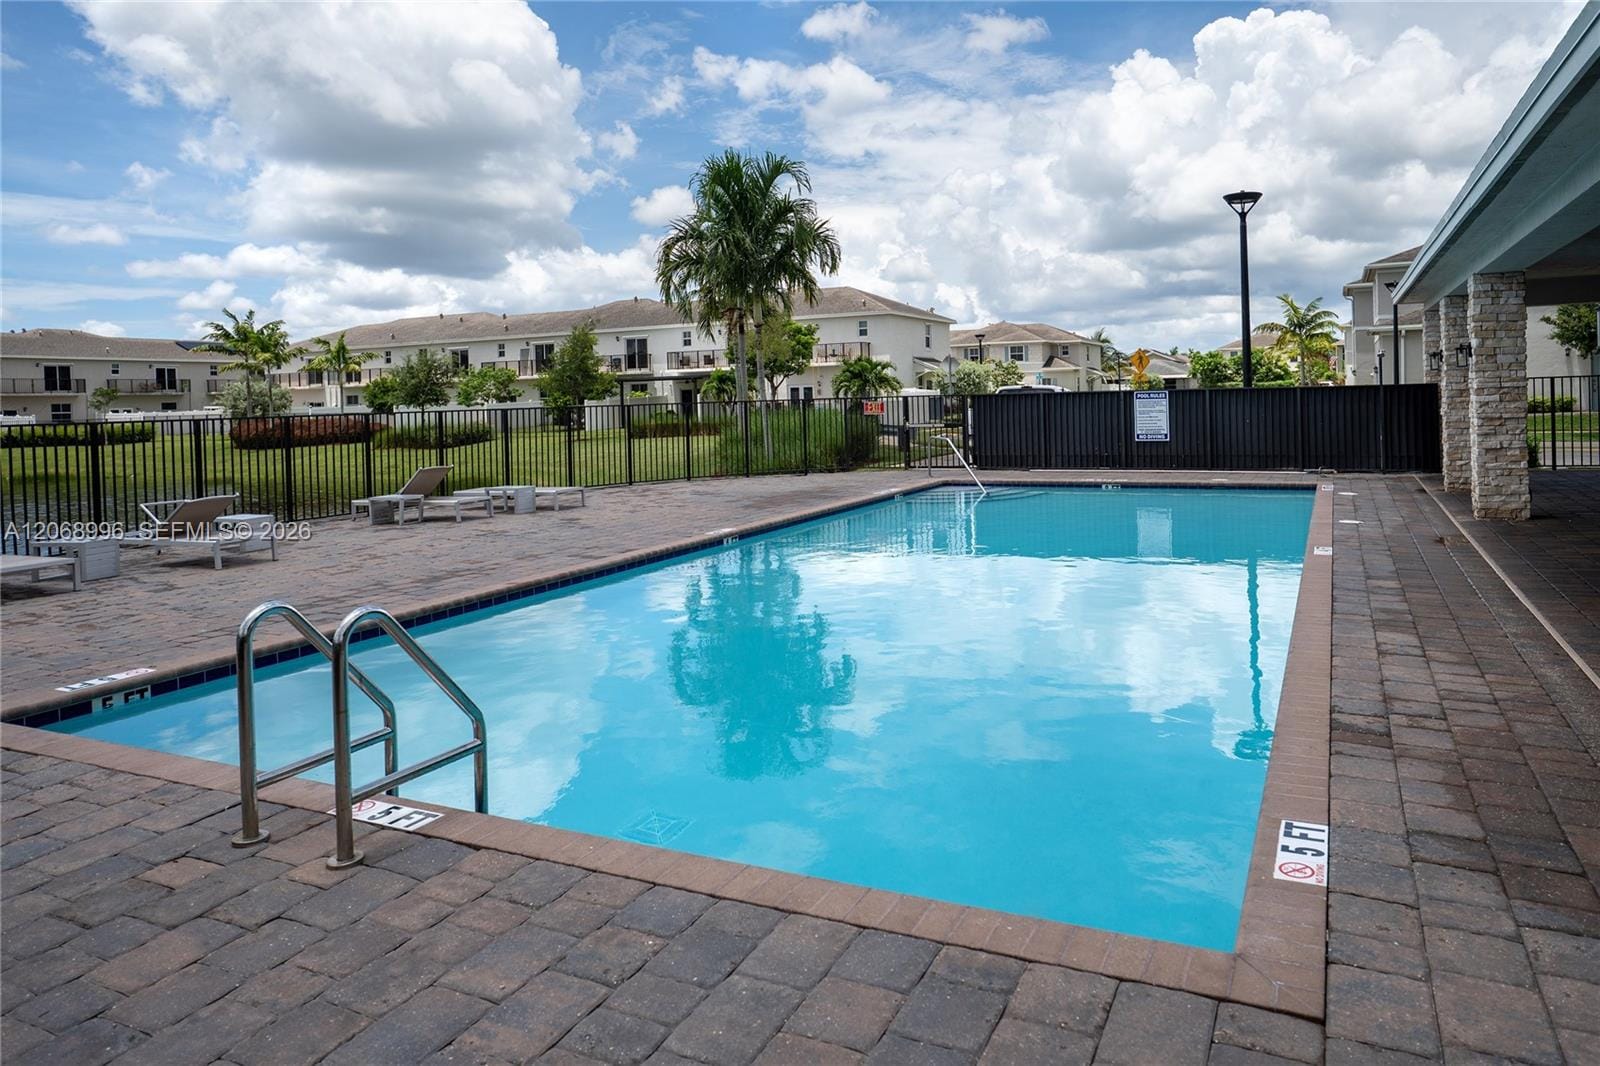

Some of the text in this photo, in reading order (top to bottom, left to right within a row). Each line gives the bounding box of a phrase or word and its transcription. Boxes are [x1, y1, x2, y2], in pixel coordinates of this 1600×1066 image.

[101, 686, 149, 710] 5 FT
[367, 805, 441, 829] 5 FT
[1280, 821, 1326, 857] 5 FT
